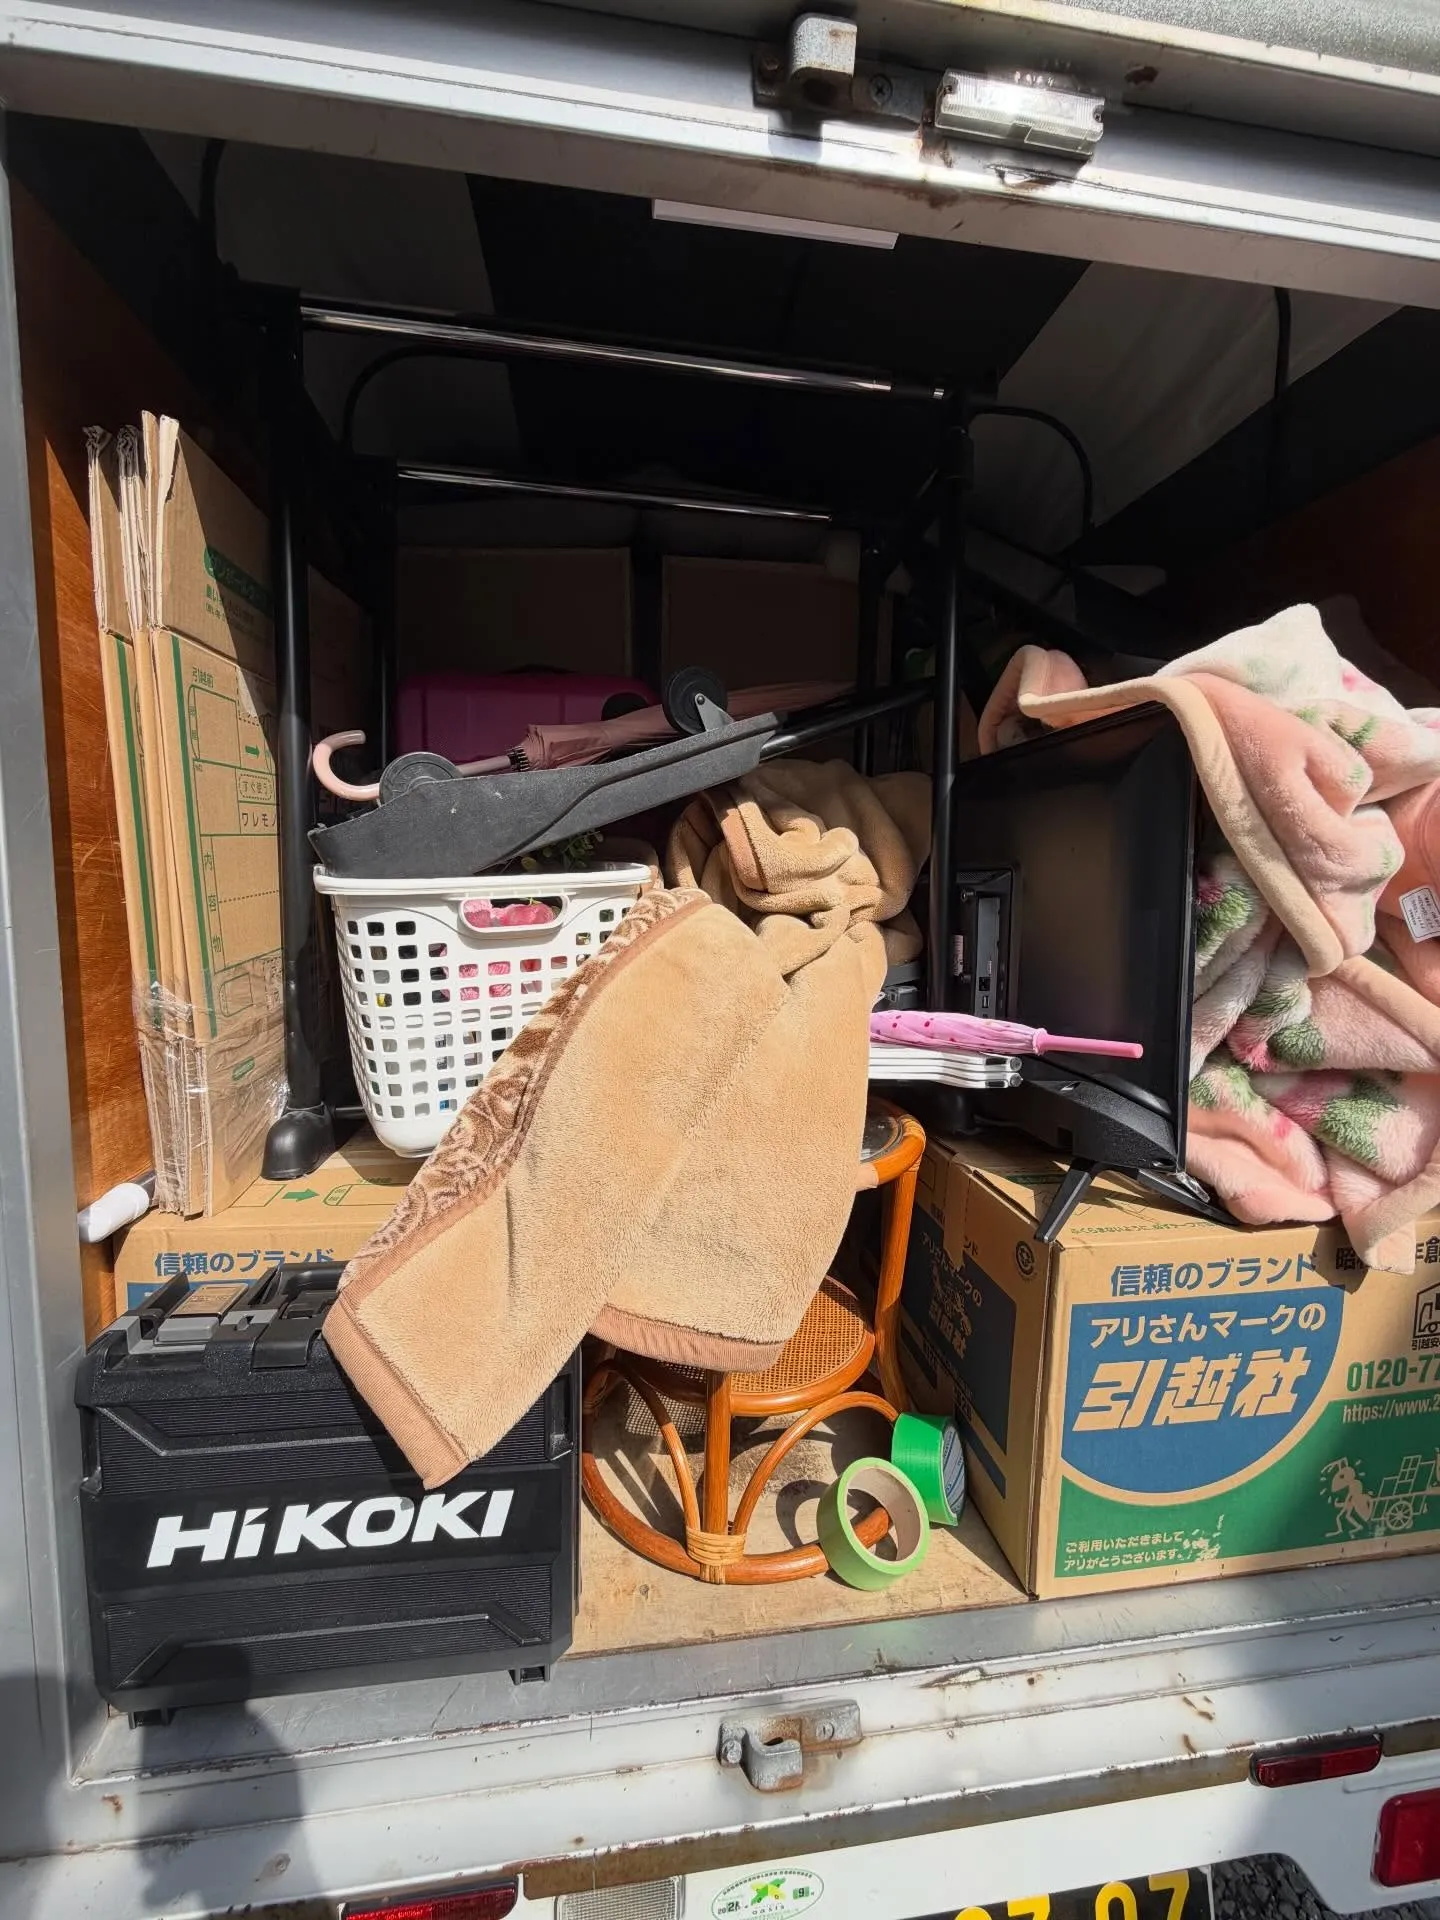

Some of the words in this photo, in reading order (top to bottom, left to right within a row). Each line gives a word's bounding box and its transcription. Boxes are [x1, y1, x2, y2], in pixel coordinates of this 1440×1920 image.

[1111, 1253, 1317, 1297] 信頼のブランド
[1090, 1303, 1326, 1349] アリさんマークの
[1072, 1346, 1312, 1432] 引越社
[146, 1489, 514, 1568] HiKOKI
[1065, 1531, 1184, 1553] ご利用いただきまして
